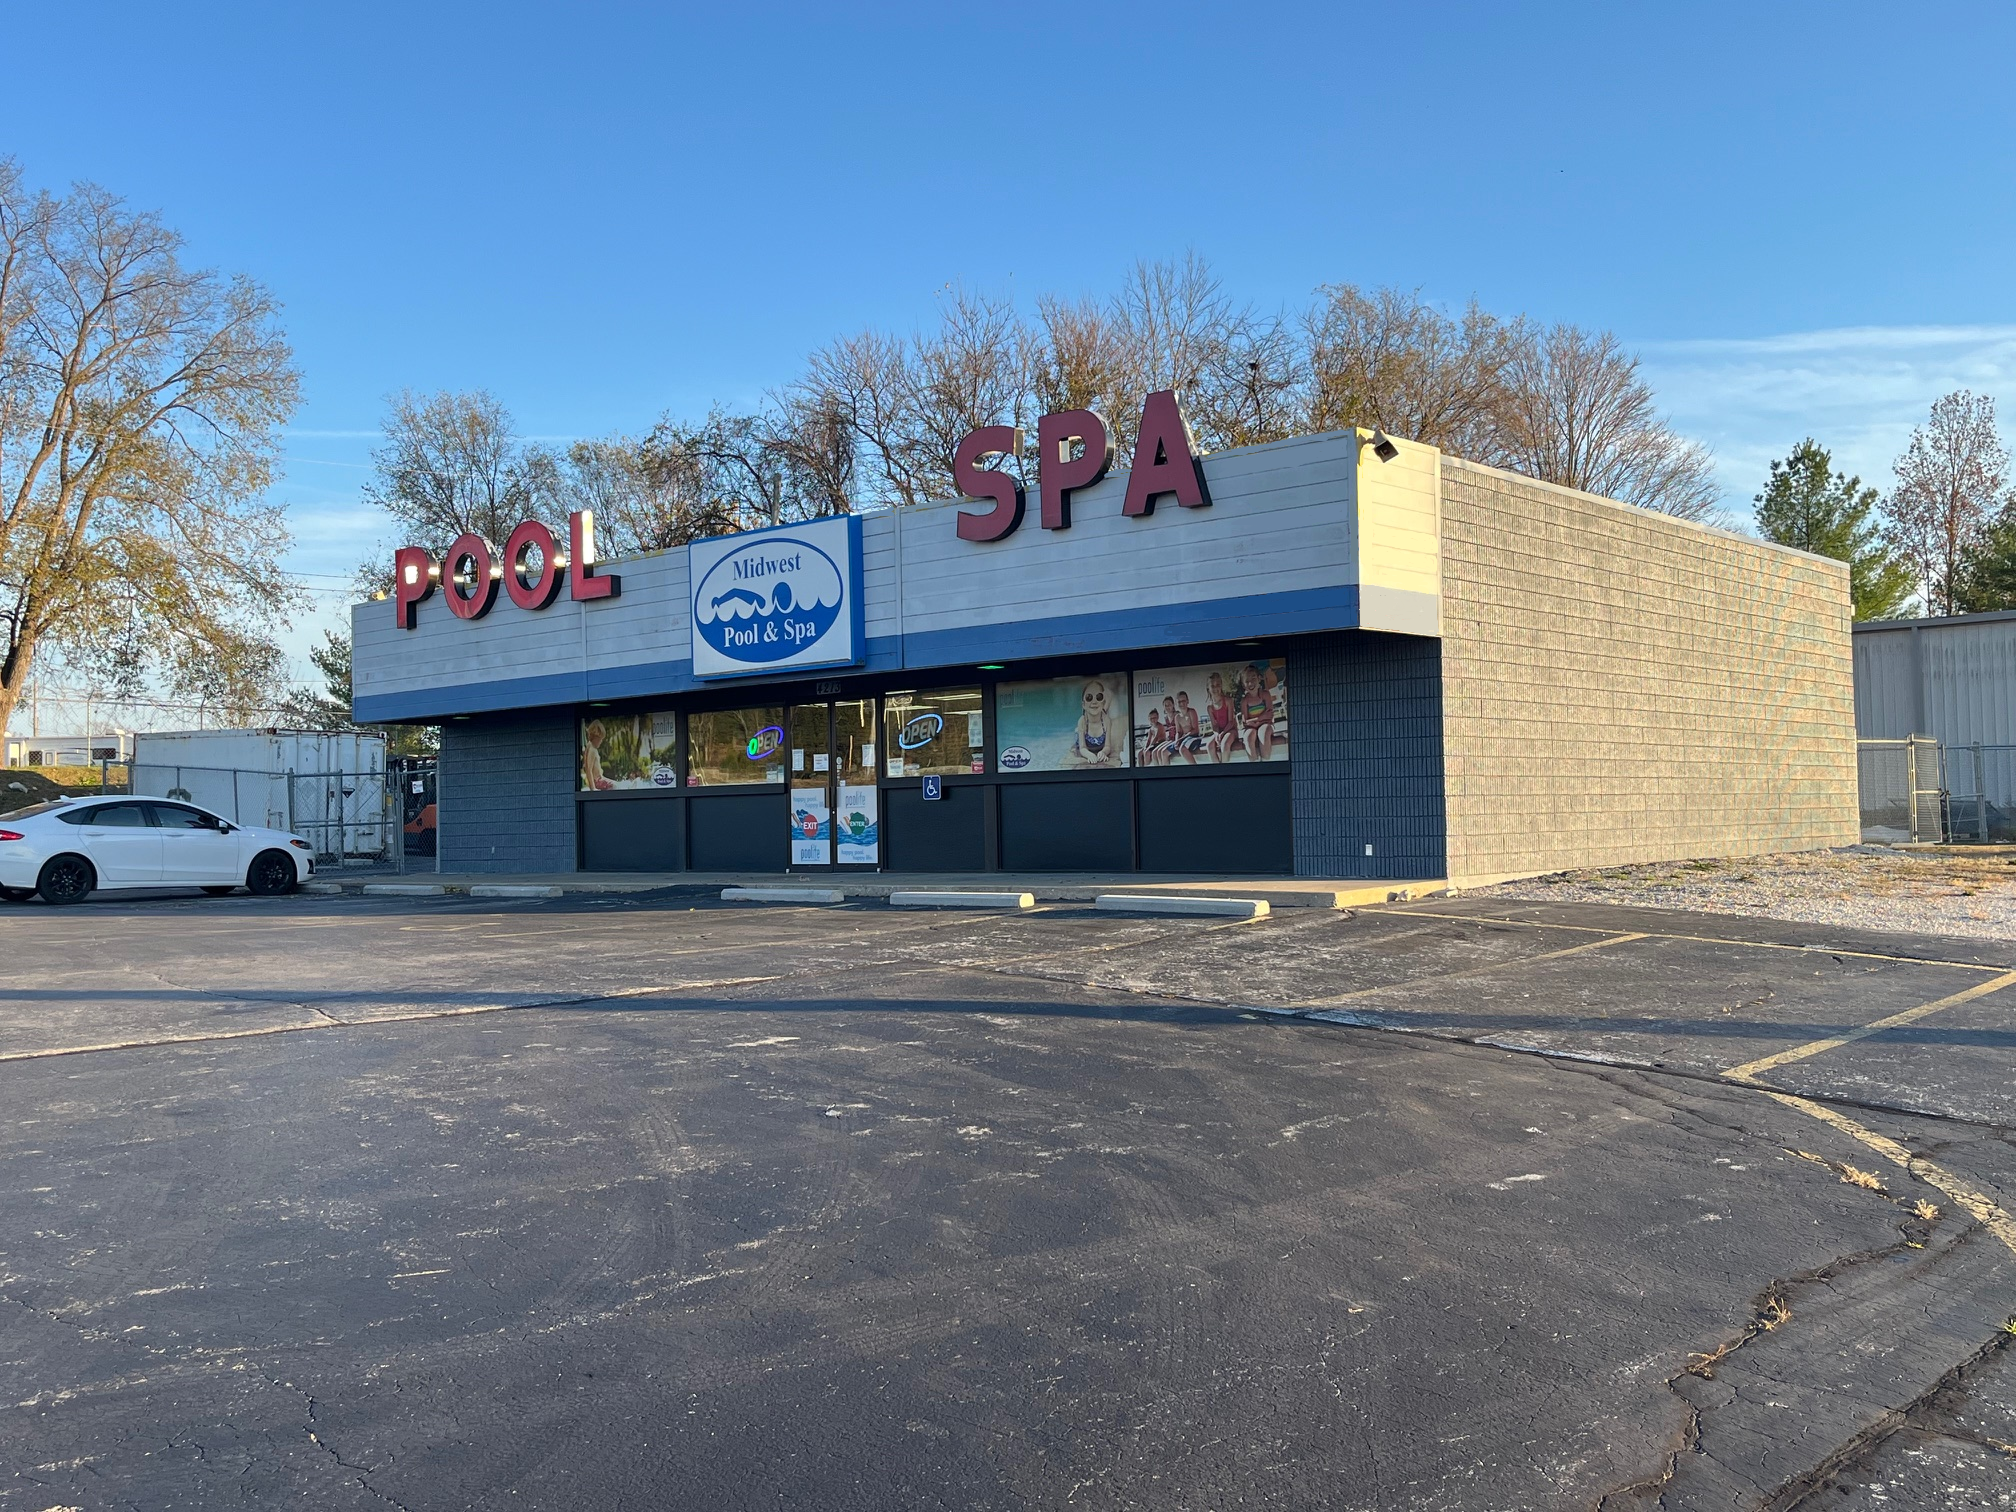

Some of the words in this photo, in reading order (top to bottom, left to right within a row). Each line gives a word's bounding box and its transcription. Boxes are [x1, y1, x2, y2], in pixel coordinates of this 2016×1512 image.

[395, 510, 621, 630] POOL
[954, 389, 1213, 542] SPA
[733, 552, 802, 581] Midwest
[723, 623, 759, 648] Pool
[763, 621, 779, 643] &
[784, 618, 816, 645] Spa
[1138, 676, 1165, 698] poolife
[653, 717, 674, 736] poolife
[903, 719, 937, 744] OPEN
[748, 730, 779, 756] OPEN
[846, 791, 866, 809] poolife
[803, 822, 818, 830] EXIT
[801, 844, 820, 862] poolife
